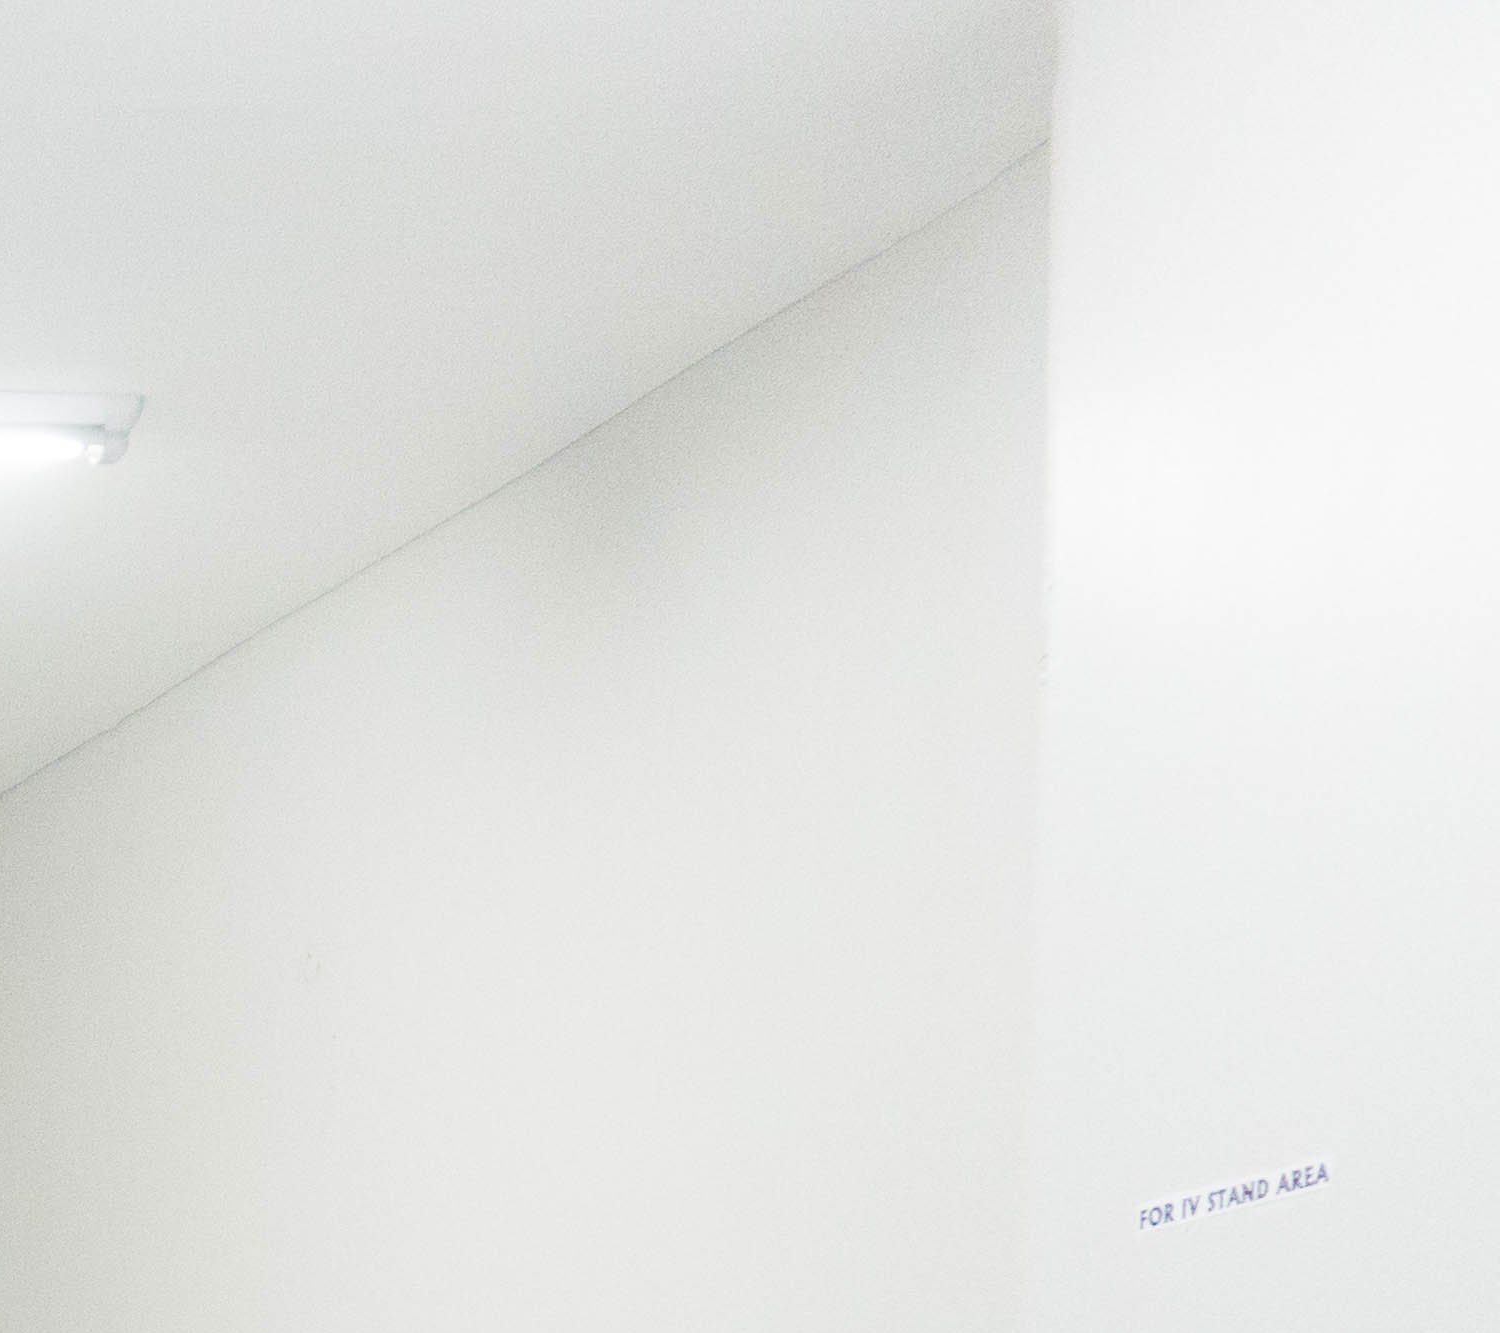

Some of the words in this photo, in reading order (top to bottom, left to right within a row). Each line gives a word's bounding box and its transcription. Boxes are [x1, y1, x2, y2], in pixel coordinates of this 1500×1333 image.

[1139, 1203, 1175, 1230] FOR
[1181, 1195, 1201, 1219] IV
[1206, 1178, 1269, 1212] STAND
[1276, 1162, 1330, 1195] AREA
